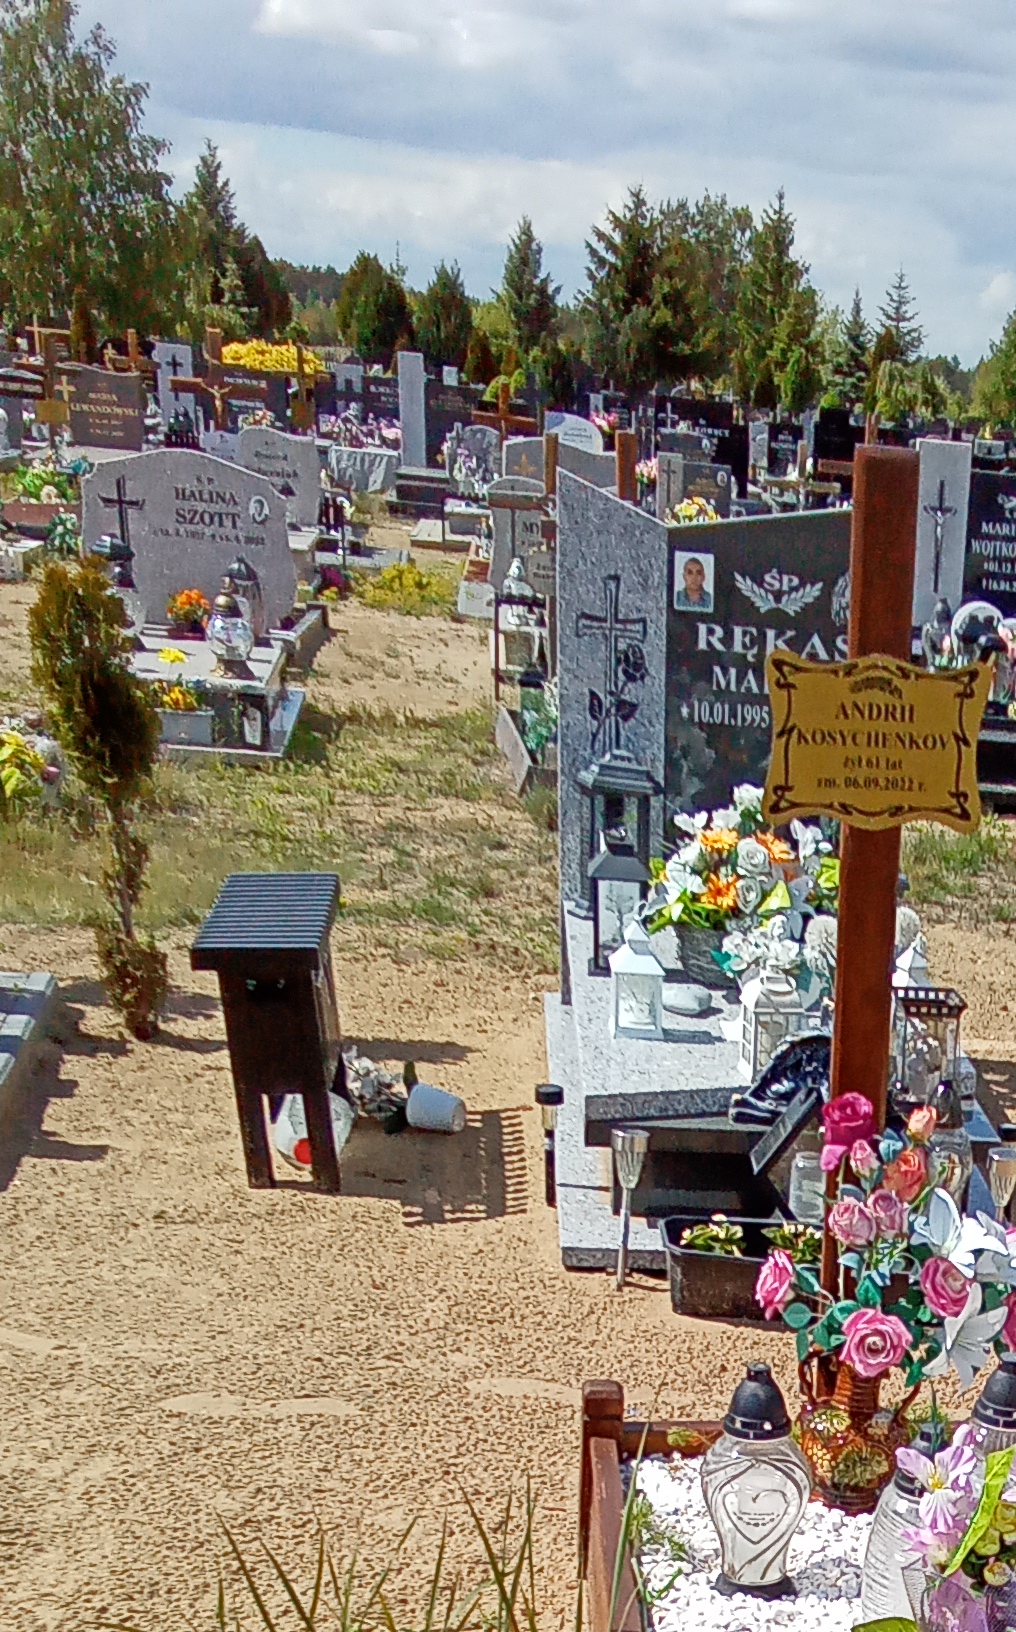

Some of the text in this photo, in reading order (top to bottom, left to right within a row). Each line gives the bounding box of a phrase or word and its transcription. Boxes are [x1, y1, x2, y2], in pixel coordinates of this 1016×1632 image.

[174, 486, 239, 507] HALINA
[175, 507, 241, 530] SZOTT
[834, 700, 917, 724] ANDRII
[796, 726, 949, 751] KOSYCHENKOV
